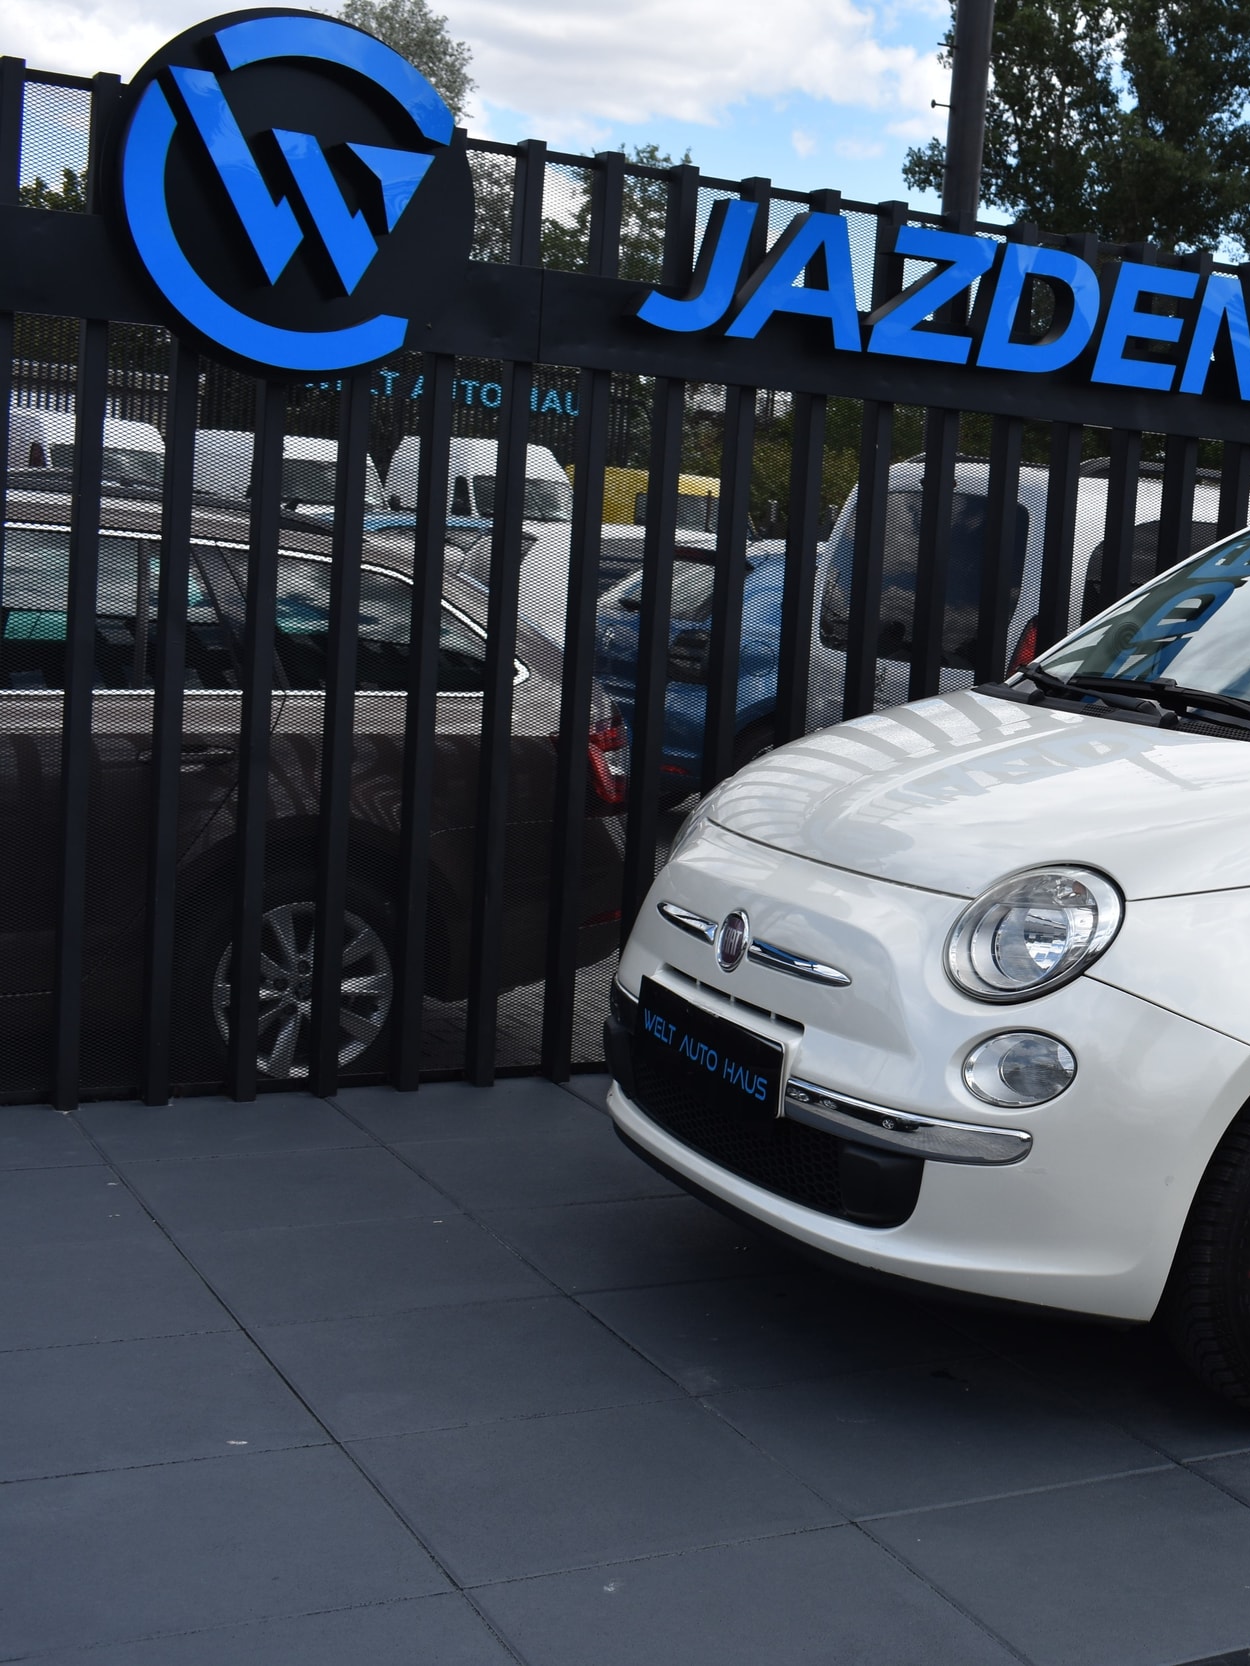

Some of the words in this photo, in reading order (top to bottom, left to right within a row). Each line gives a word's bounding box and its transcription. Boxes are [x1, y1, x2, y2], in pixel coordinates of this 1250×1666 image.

[644, 1007, 677, 1046] WELT
[679, 1034, 718, 1072] AUTO
[723, 1057, 768, 1101] HAUS
